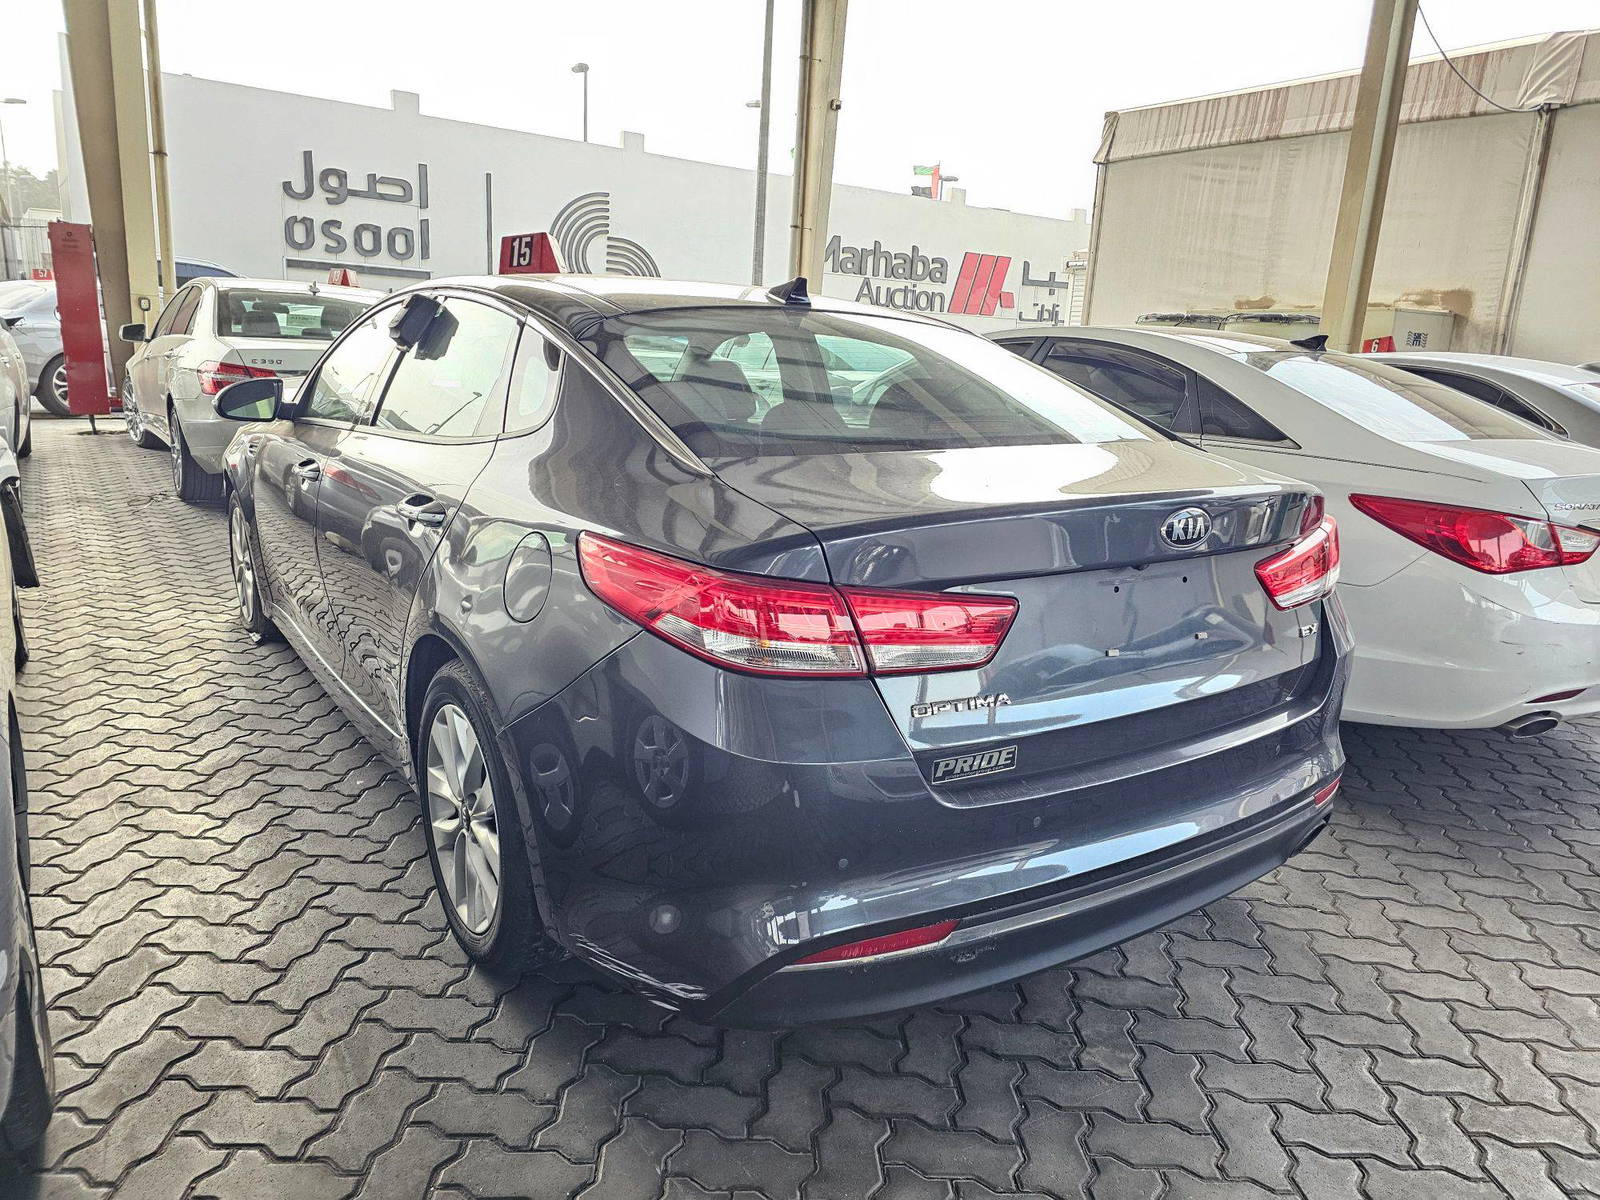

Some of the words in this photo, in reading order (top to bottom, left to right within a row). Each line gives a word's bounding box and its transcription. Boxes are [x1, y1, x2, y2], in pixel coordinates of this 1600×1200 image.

[282, 150, 429, 209] اصول
[285, 216, 430, 260] osool
[512, 236, 531, 267] 15
[855, 277, 946, 313] Auction
[1371, 339, 1380, 353] 6
[1172, 517, 1205, 541] KIA
[1299, 623, 1319, 639] EX
[911, 692, 1012, 718] OPTIMA
[935, 747, 1015, 778] PRIDE
